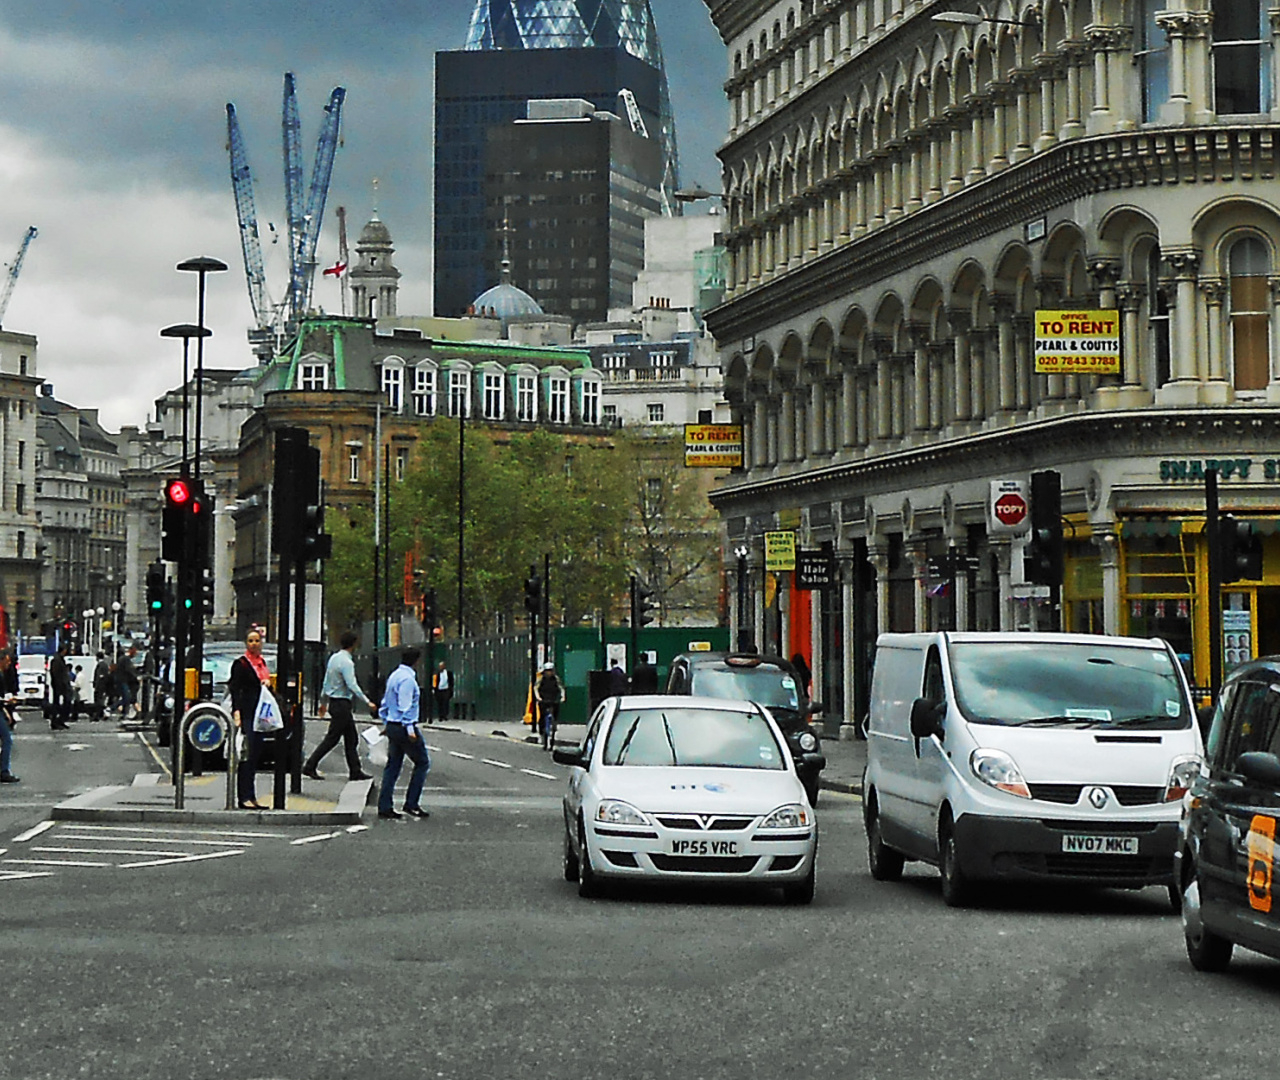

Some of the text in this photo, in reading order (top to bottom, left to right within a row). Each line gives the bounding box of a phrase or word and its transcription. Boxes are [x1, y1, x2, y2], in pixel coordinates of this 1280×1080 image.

[1040, 321, 1114, 334] TO RENT
[1035, 340, 1118, 351] PEARL & COUTTS
[1039, 357, 1058, 365] 020
[1061, 357, 1087, 365] 7843
[689, 432, 738, 440] TO RENT
[1159, 459, 1252, 480] SNAPPY
[996, 505, 1024, 514] TOPY
[804, 565, 826, 573] Hair
[801, 574, 828, 583] Salon
[672, 840, 737, 854] WP55 VRC
[1067, 836, 1103, 850] NV07
